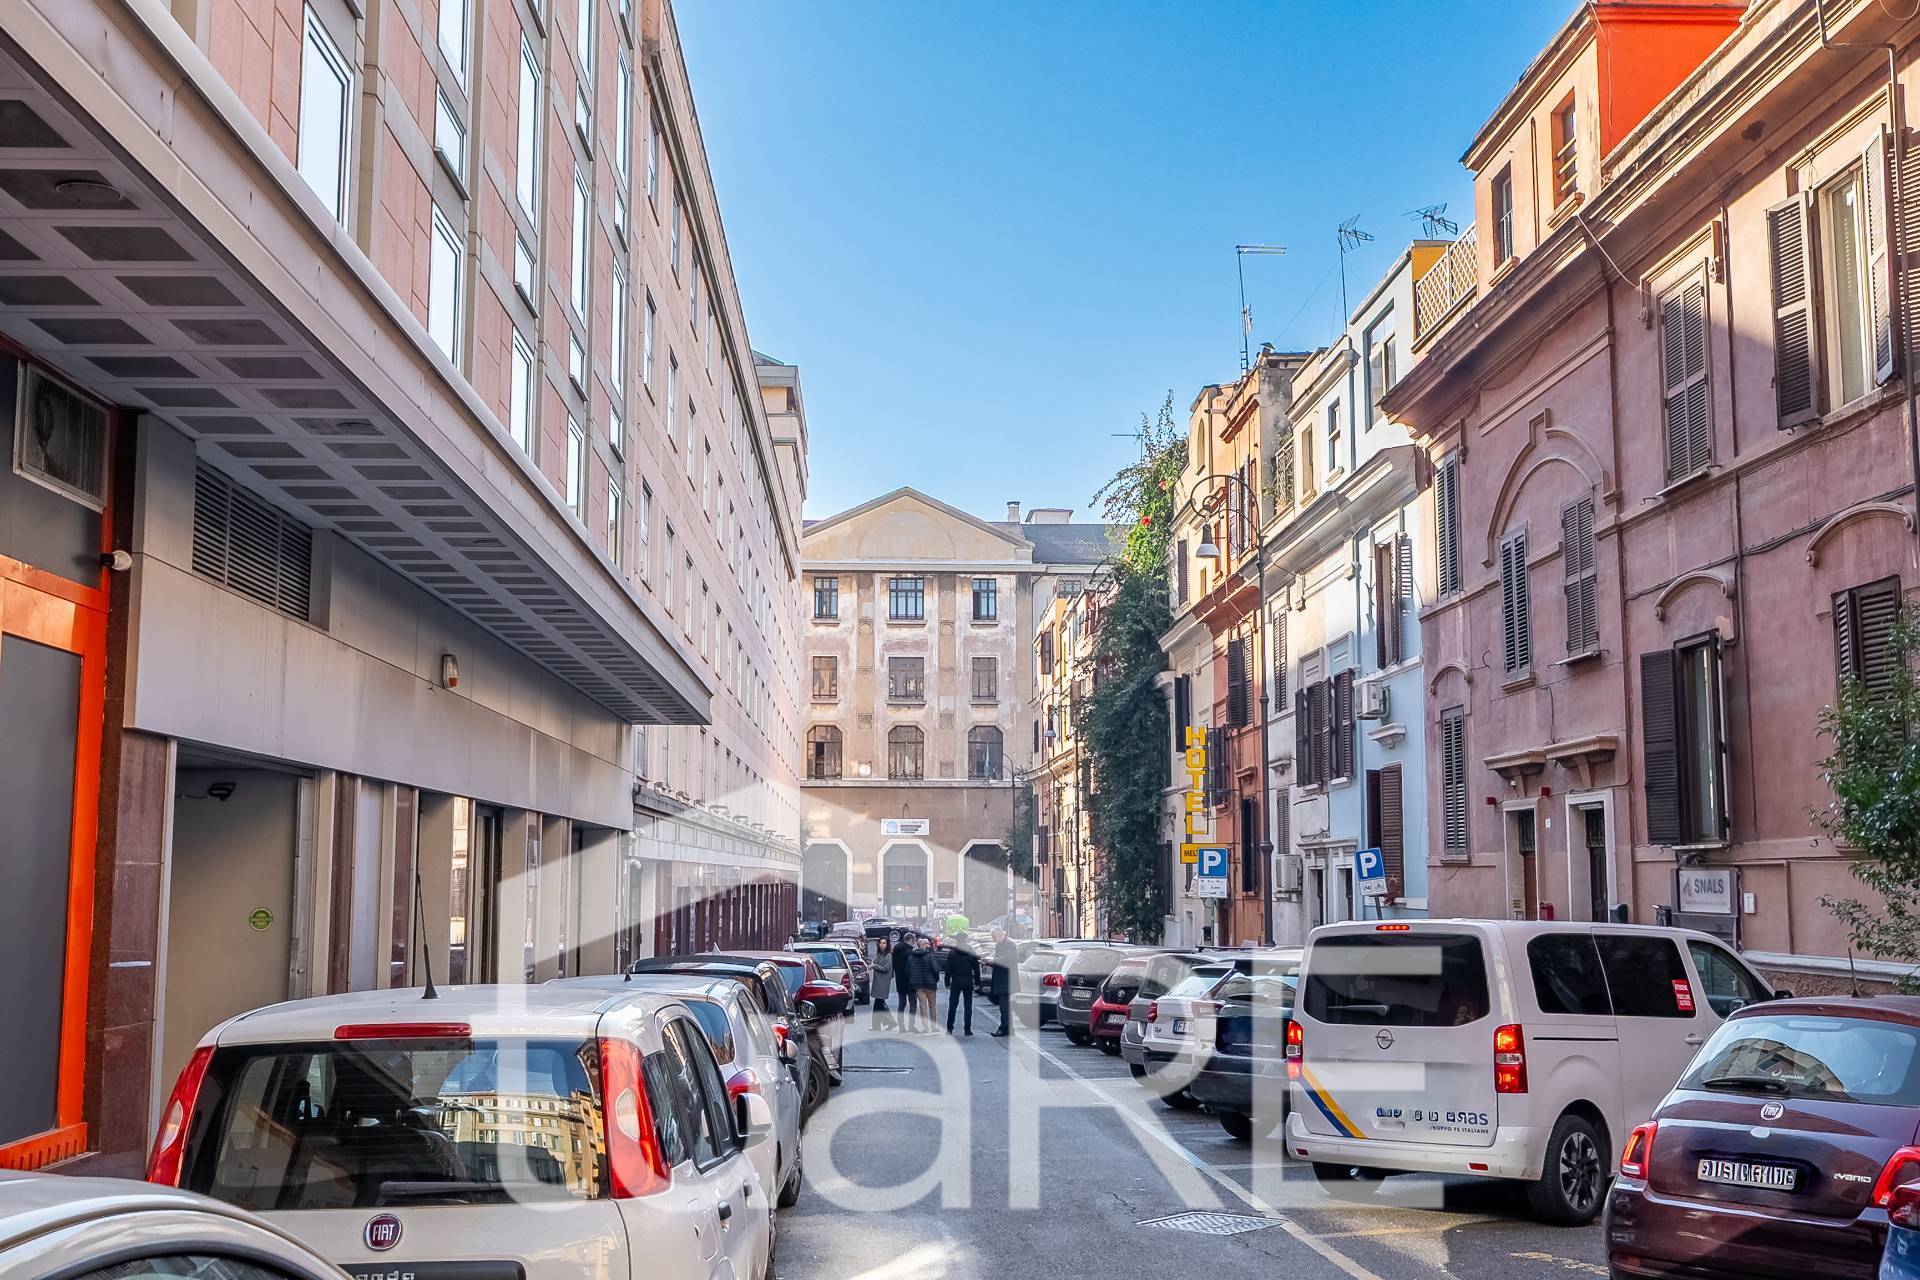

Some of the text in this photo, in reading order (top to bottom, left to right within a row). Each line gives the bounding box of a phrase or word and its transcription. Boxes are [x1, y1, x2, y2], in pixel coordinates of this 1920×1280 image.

[1185, 726, 1207, 834] HOTEL
[1184, 849, 1199, 858] MEL
[1203, 850, 1222, 875] P
[1360, 852, 1377, 877] P
[1694, 878, 1724, 894] SNALS
[372, 1223, 395, 1241] FIAT
